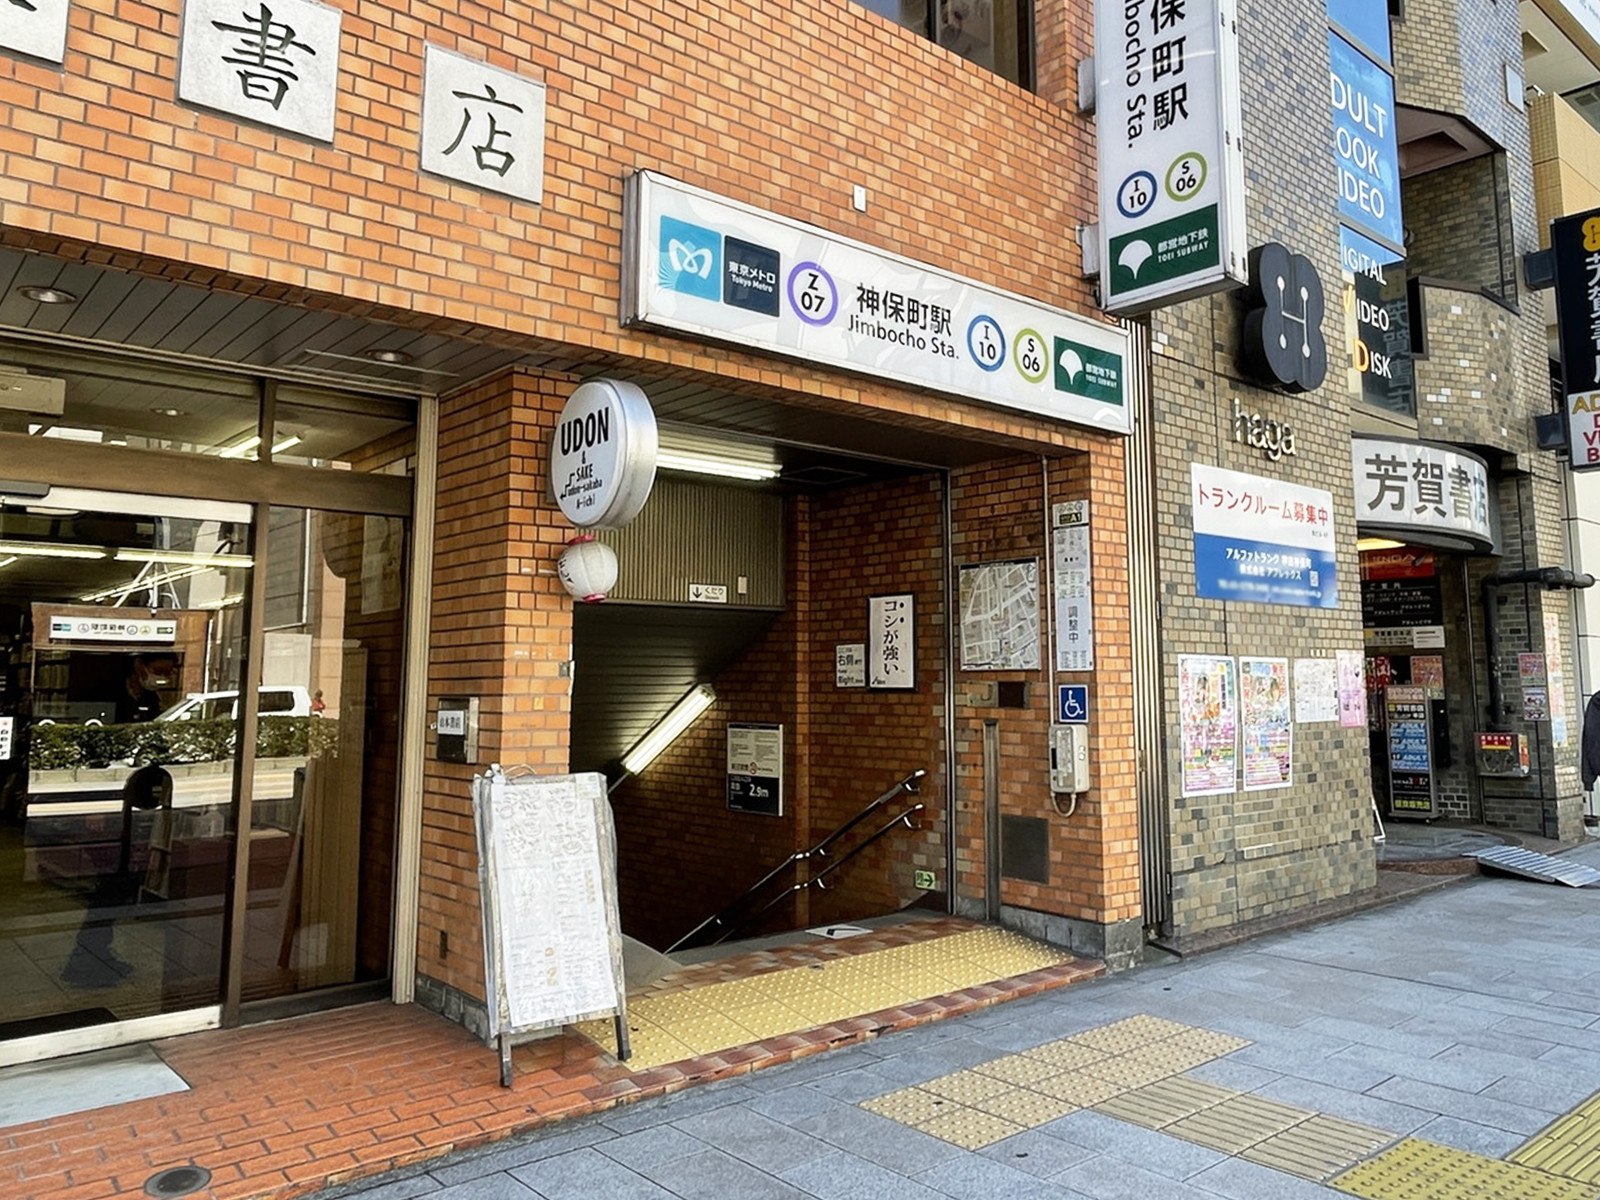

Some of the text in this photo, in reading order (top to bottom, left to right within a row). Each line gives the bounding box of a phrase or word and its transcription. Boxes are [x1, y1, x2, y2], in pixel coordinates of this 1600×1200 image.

[1125, 0, 1147, 149] bocho Sta.
[1181, 160, 1190, 175] S
[1175, 174, 1197, 192] 06
[1129, 191, 1147, 208] 10
[1176, 240, 1209, 257] SUBWAY
[729, 261, 776, 284] 東京メトロ
[808, 273, 819, 291] Z
[731, 274, 773, 293] Tokyo Metro
[801, 291, 825, 312] 07
[856, 282, 952, 337] 神保町駅
[848, 314, 960, 360] Jimbocho Sta.
[1027, 338, 1035, 353] S
[979, 341, 996, 360] 10
[1353, 338, 1392, 380] DISK
[1022, 354, 1040, 372] 06
[561, 406, 609, 456] UDON
[1233, 398, 1296, 460] haga
[576, 463, 593, 482] SAKE
[1364, 453, 1487, 526] 芳賀書店
[1199, 483, 1328, 526] トランクルーム募集中
[705, 586, 724, 596] くだり
[1067, 606, 1079, 644] 調整中
[883, 600, 899, 676] コシが強い
